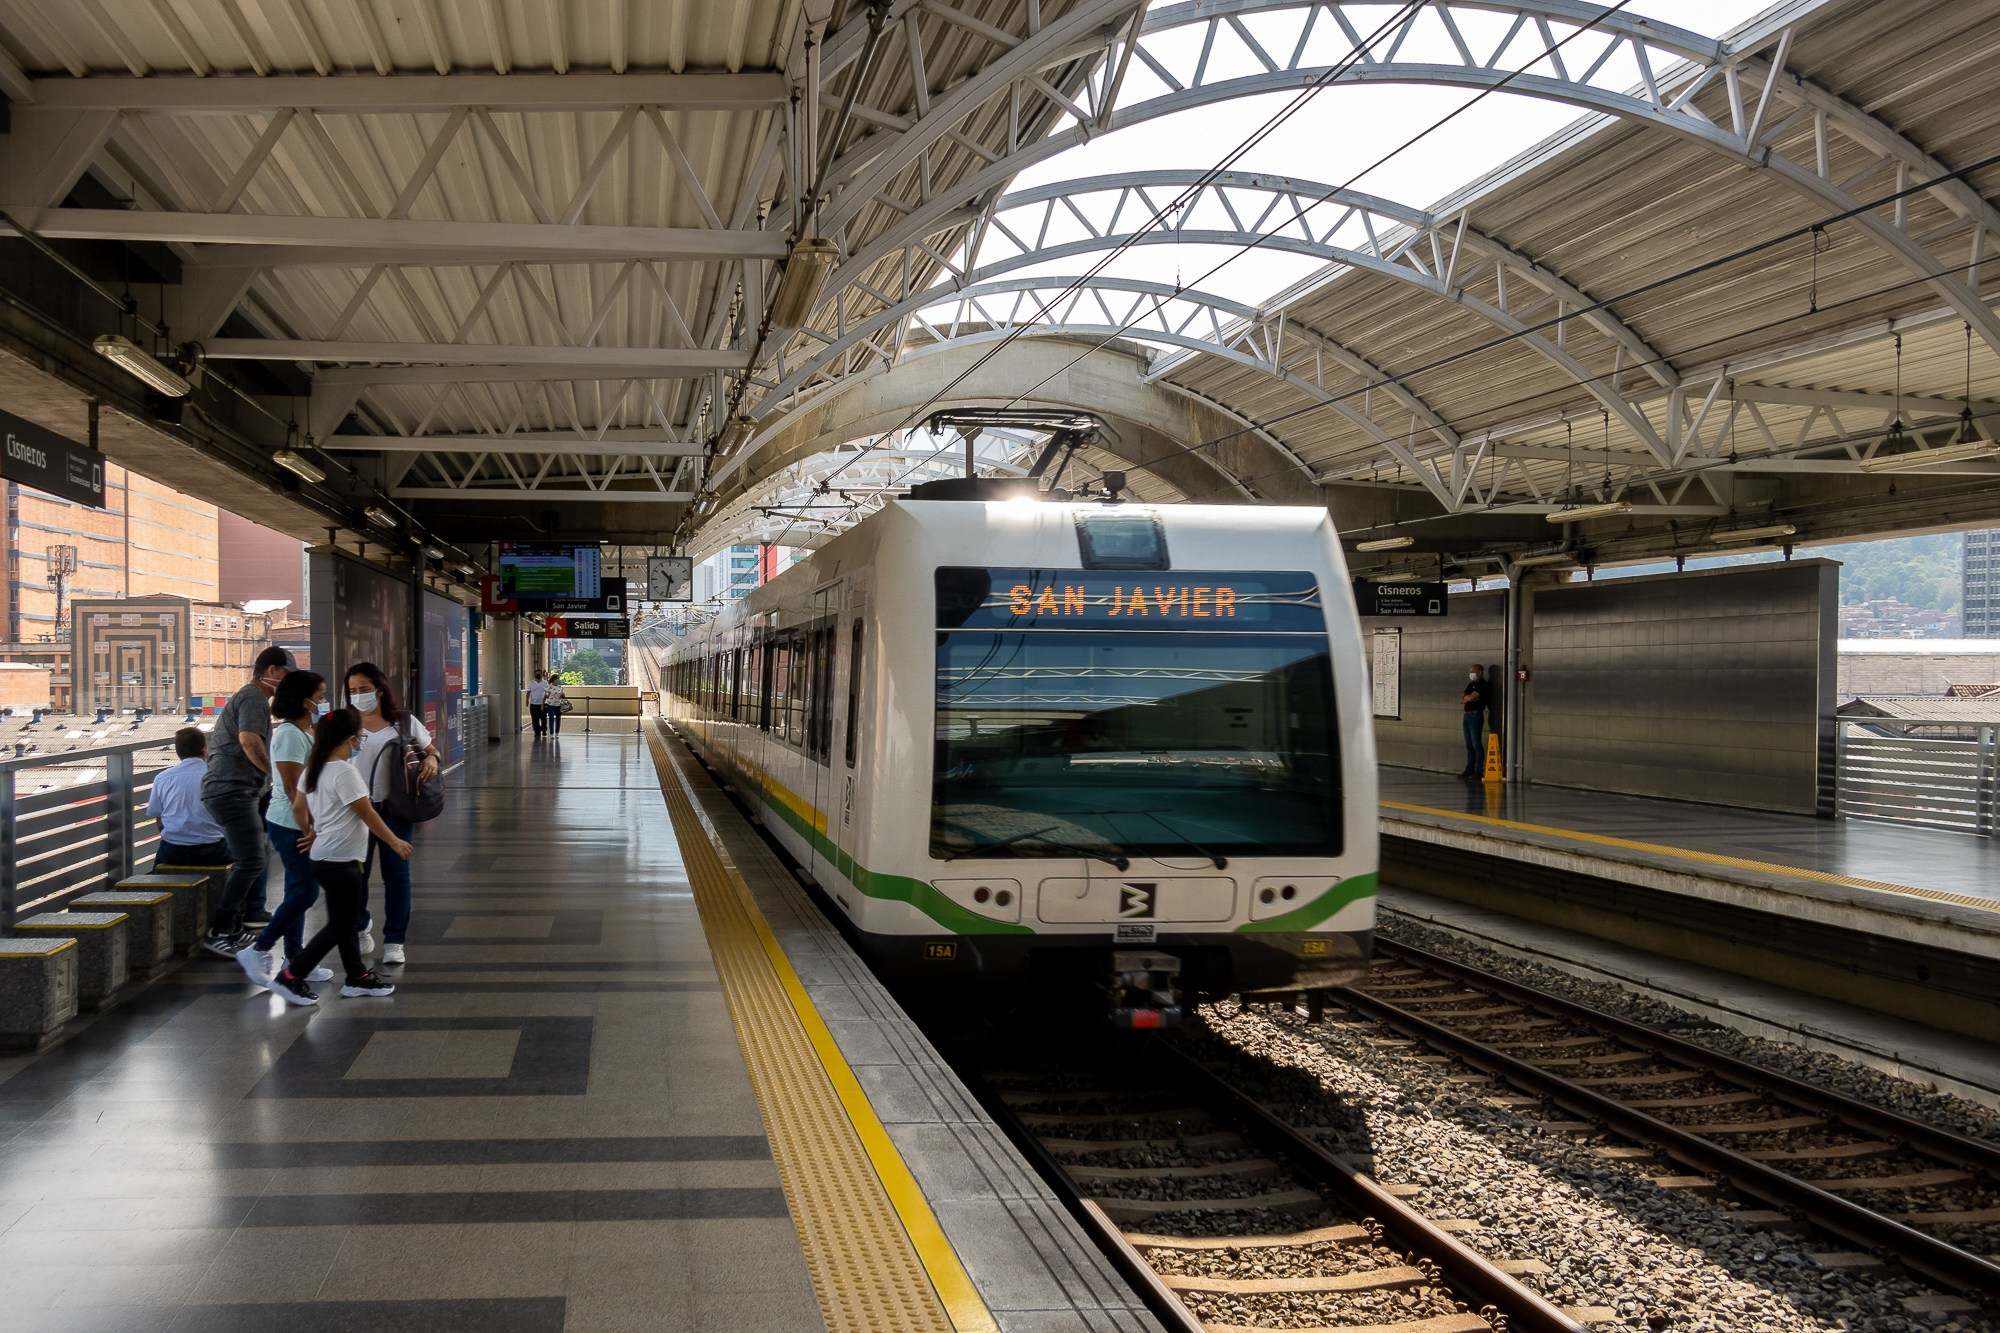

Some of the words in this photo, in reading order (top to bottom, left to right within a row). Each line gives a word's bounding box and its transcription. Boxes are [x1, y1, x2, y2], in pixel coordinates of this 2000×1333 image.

[7, 433, 47, 468] Cisneros
[1378, 585, 1422, 595] Cisneros
[1009, 585, 1085, 615] SAN
[1108, 586, 1237, 617] JAVIER
[574, 621, 600, 630] Salida
[928, 945, 952, 957] 15A
